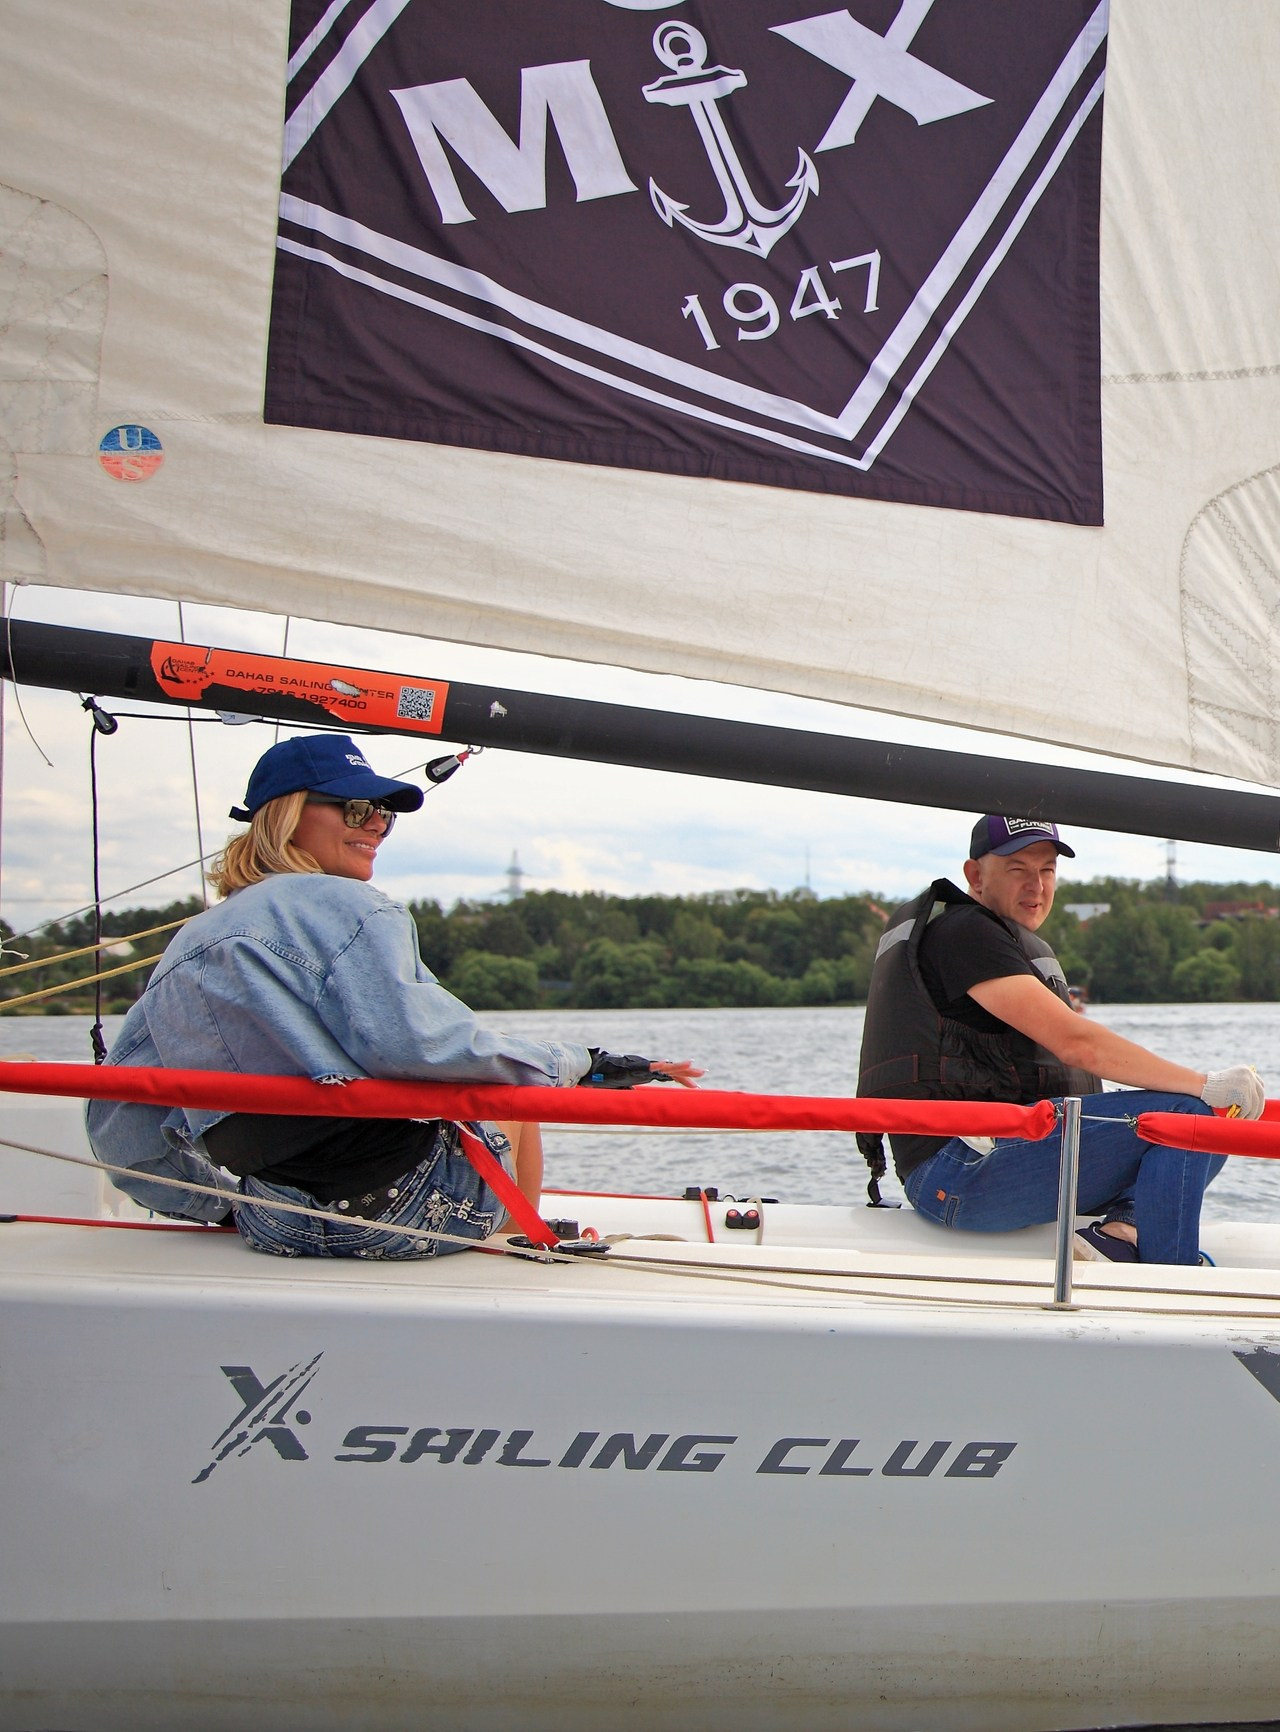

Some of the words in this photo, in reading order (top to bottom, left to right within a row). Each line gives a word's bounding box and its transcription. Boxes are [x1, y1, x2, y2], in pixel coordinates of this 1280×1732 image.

[681, 249, 883, 352] 1947
[226, 669, 274, 683] DAHAB
[279, 676, 333, 691] SAILING
[301, 692, 367, 710] 1927400
[334, 1425, 738, 1474] SAILING
[756, 1438, 1019, 1479] CLUB
